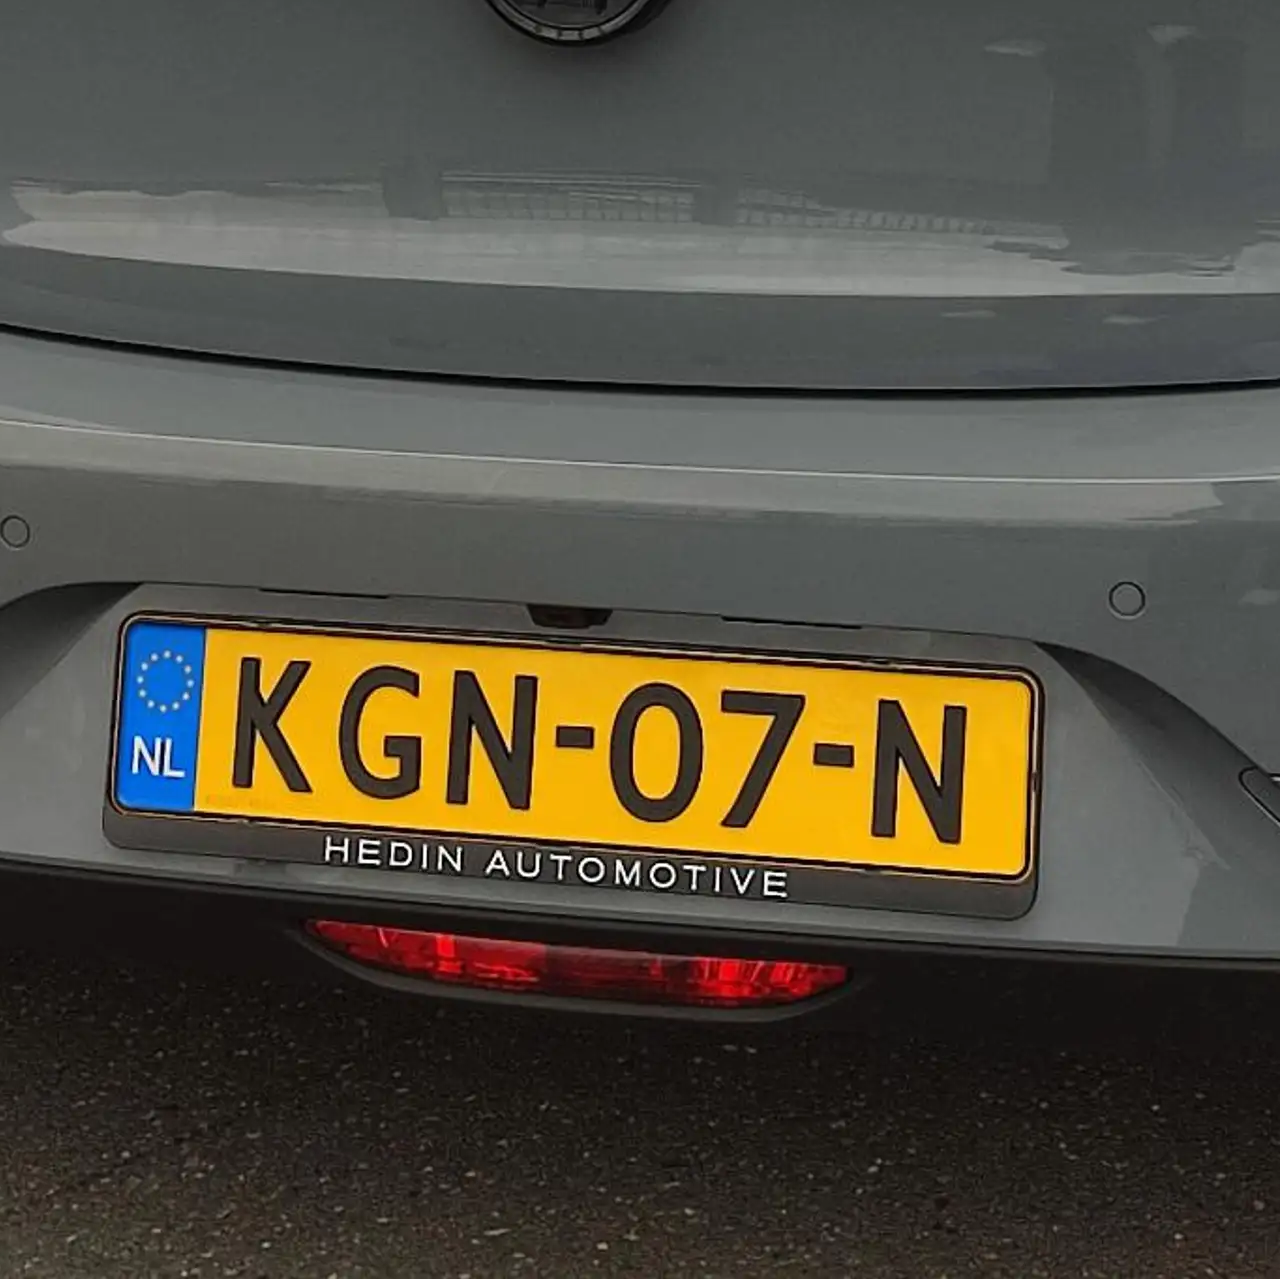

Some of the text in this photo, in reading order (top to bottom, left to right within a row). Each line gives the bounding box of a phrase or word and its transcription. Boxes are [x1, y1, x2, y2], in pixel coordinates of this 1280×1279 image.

[131, 735, 186, 778] NL
[231, 656, 968, 845] KGN-07-N
[323, 835, 789, 899] HEDIN AUTOMOTIVE
